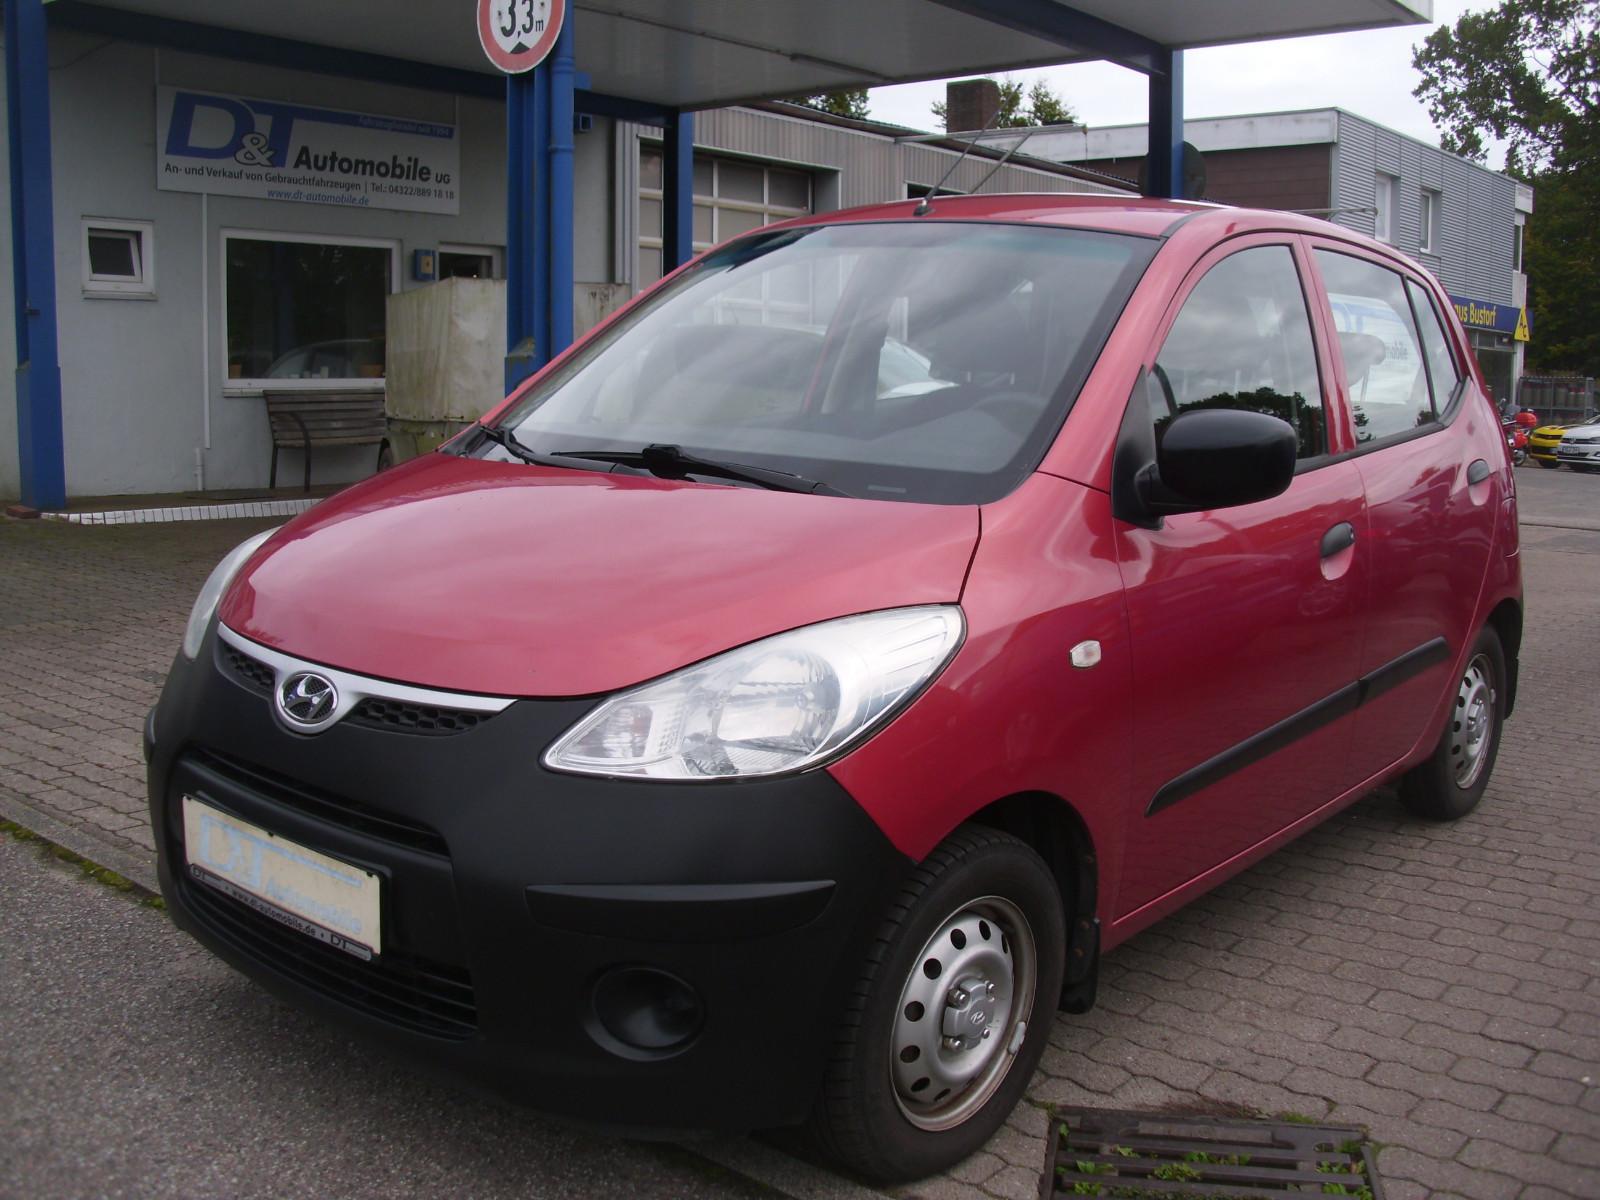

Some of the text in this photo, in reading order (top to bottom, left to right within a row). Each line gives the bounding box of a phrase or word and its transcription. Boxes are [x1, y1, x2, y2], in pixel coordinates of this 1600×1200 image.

[165, 91, 310, 168] D&T
[165, 162, 182, 174] An-
[184, 166, 204, 176] und
[206, 167, 243, 179] Verkauf
[245, 171, 262, 181] von
[265, 172, 361, 191] Gebrauchtfahrzeugen
[293, 145, 451, 184] Automobile UG
[267, 189, 369, 206] www.dt-automobile.de
[1469, 302, 1497, 327] Bustorf
